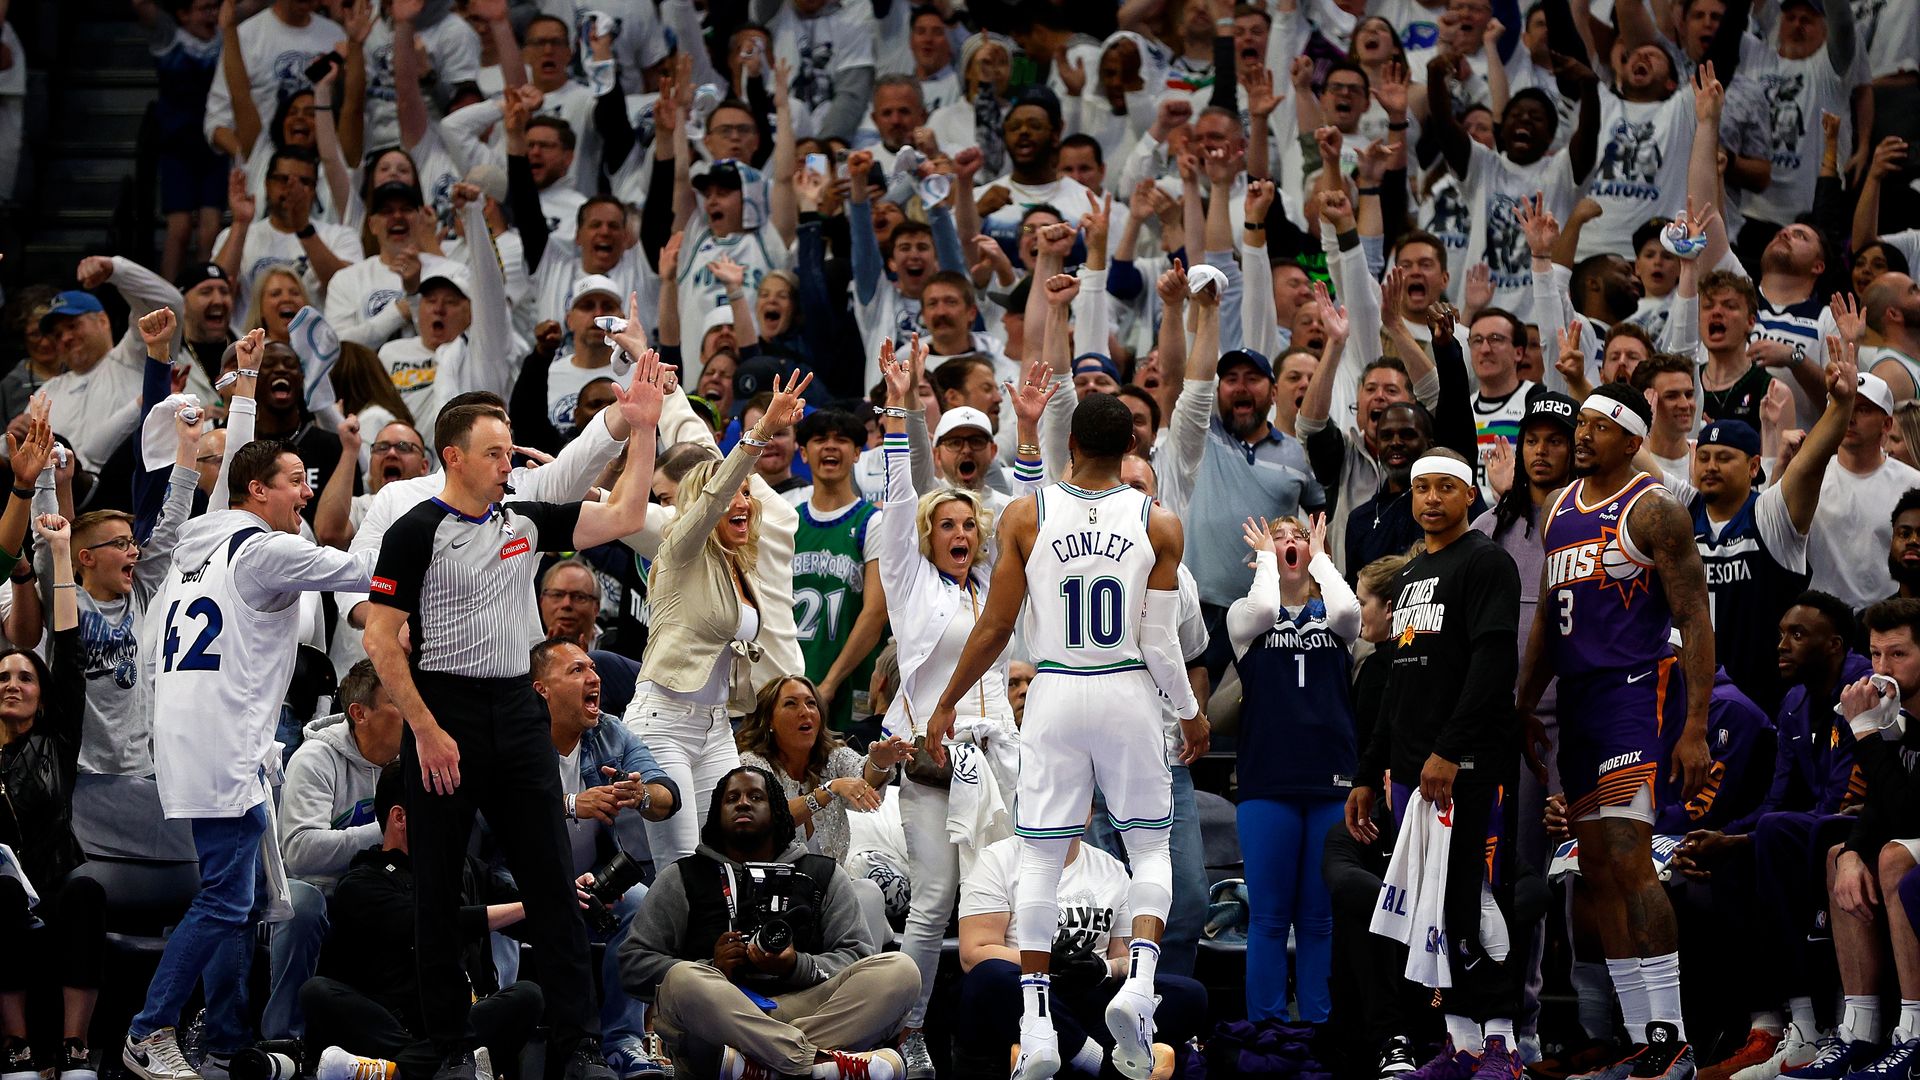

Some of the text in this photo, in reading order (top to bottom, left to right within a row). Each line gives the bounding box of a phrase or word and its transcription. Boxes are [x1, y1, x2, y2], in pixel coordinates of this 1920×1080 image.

[1599, 511, 1619, 521] PayPal
[502, 541, 528, 556] Emirates
[1051, 531, 1135, 563] CONLEY
[1703, 559, 1752, 585] ESOTA
[1406, 576, 1440, 607] TAKES
[794, 587, 847, 641] 21
[1060, 575, 1126, 649] 10
[1557, 589, 1574, 636] 3
[163, 596, 224, 674] 42
[1264, 632, 1338, 651] MINNSOTA
[1294, 653, 1306, 688] 1
[1598, 750, 1643, 776] PHOENIX
[1381, 882, 1407, 917] AL
